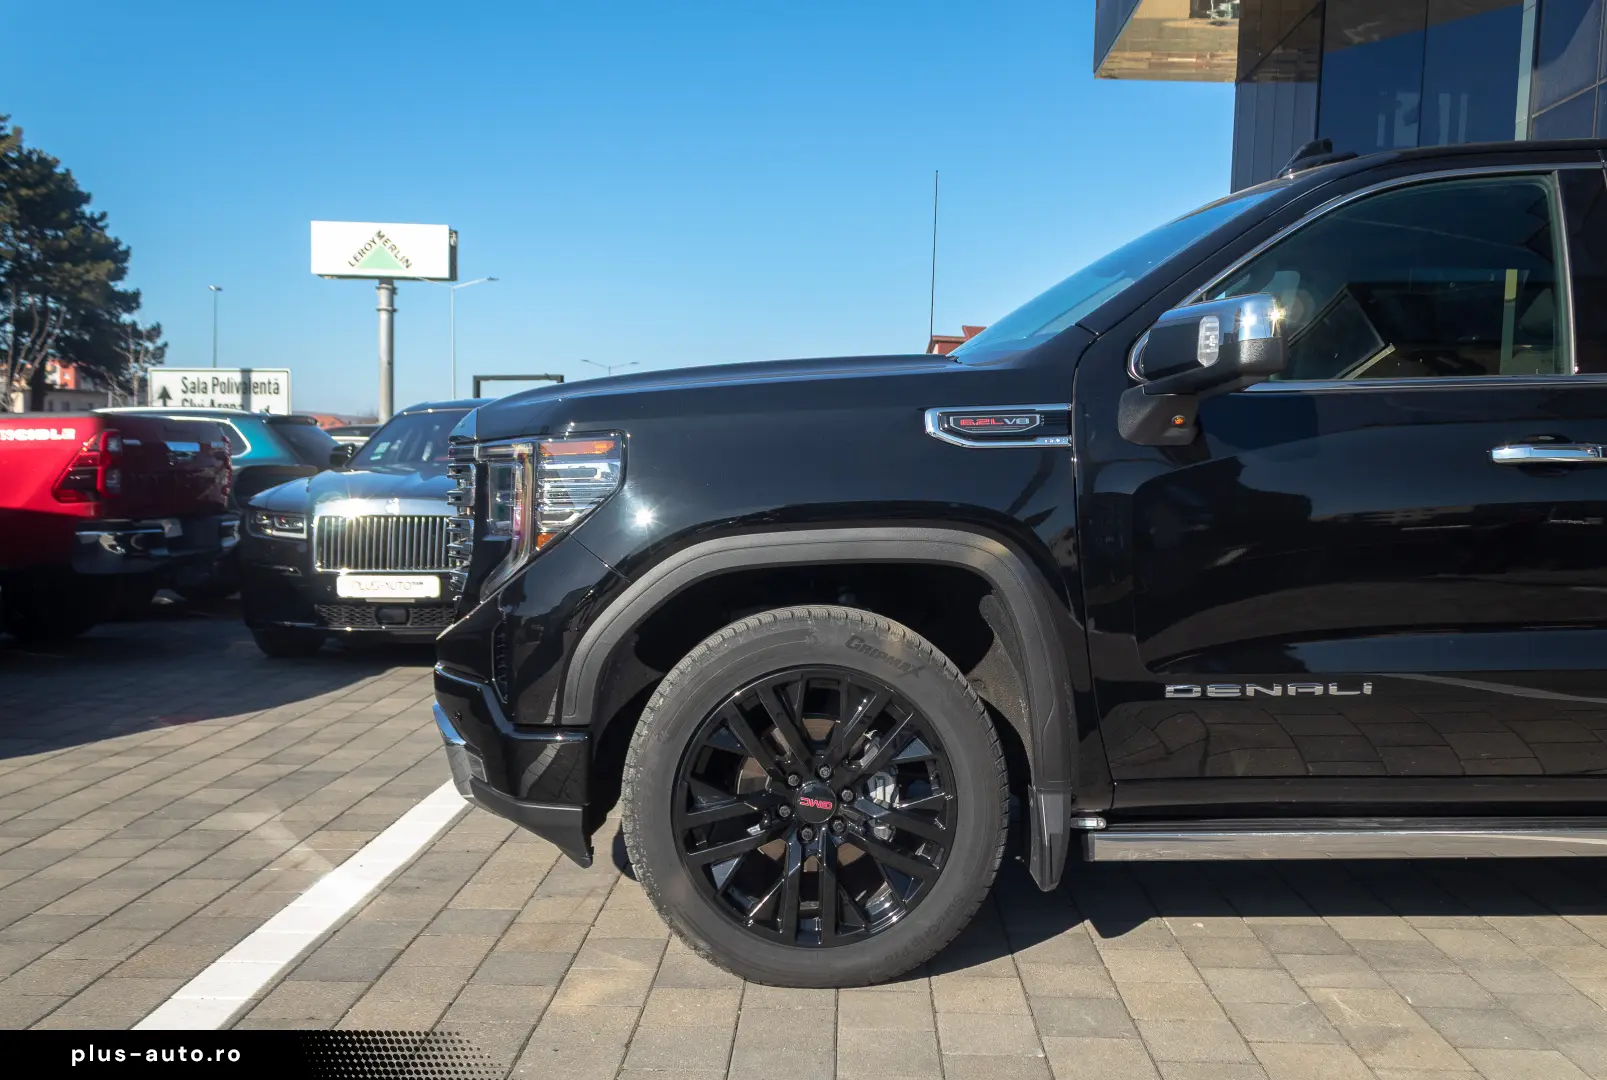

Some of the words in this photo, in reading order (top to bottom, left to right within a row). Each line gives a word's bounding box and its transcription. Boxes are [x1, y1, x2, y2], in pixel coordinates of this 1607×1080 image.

[348, 237, 377, 267] LEROY
[376, 230, 412, 269] MERLIN
[181, 376, 208, 395] Sala
[1165, 682, 1373, 698] DENALI
[799, 797, 832, 811] GMC
